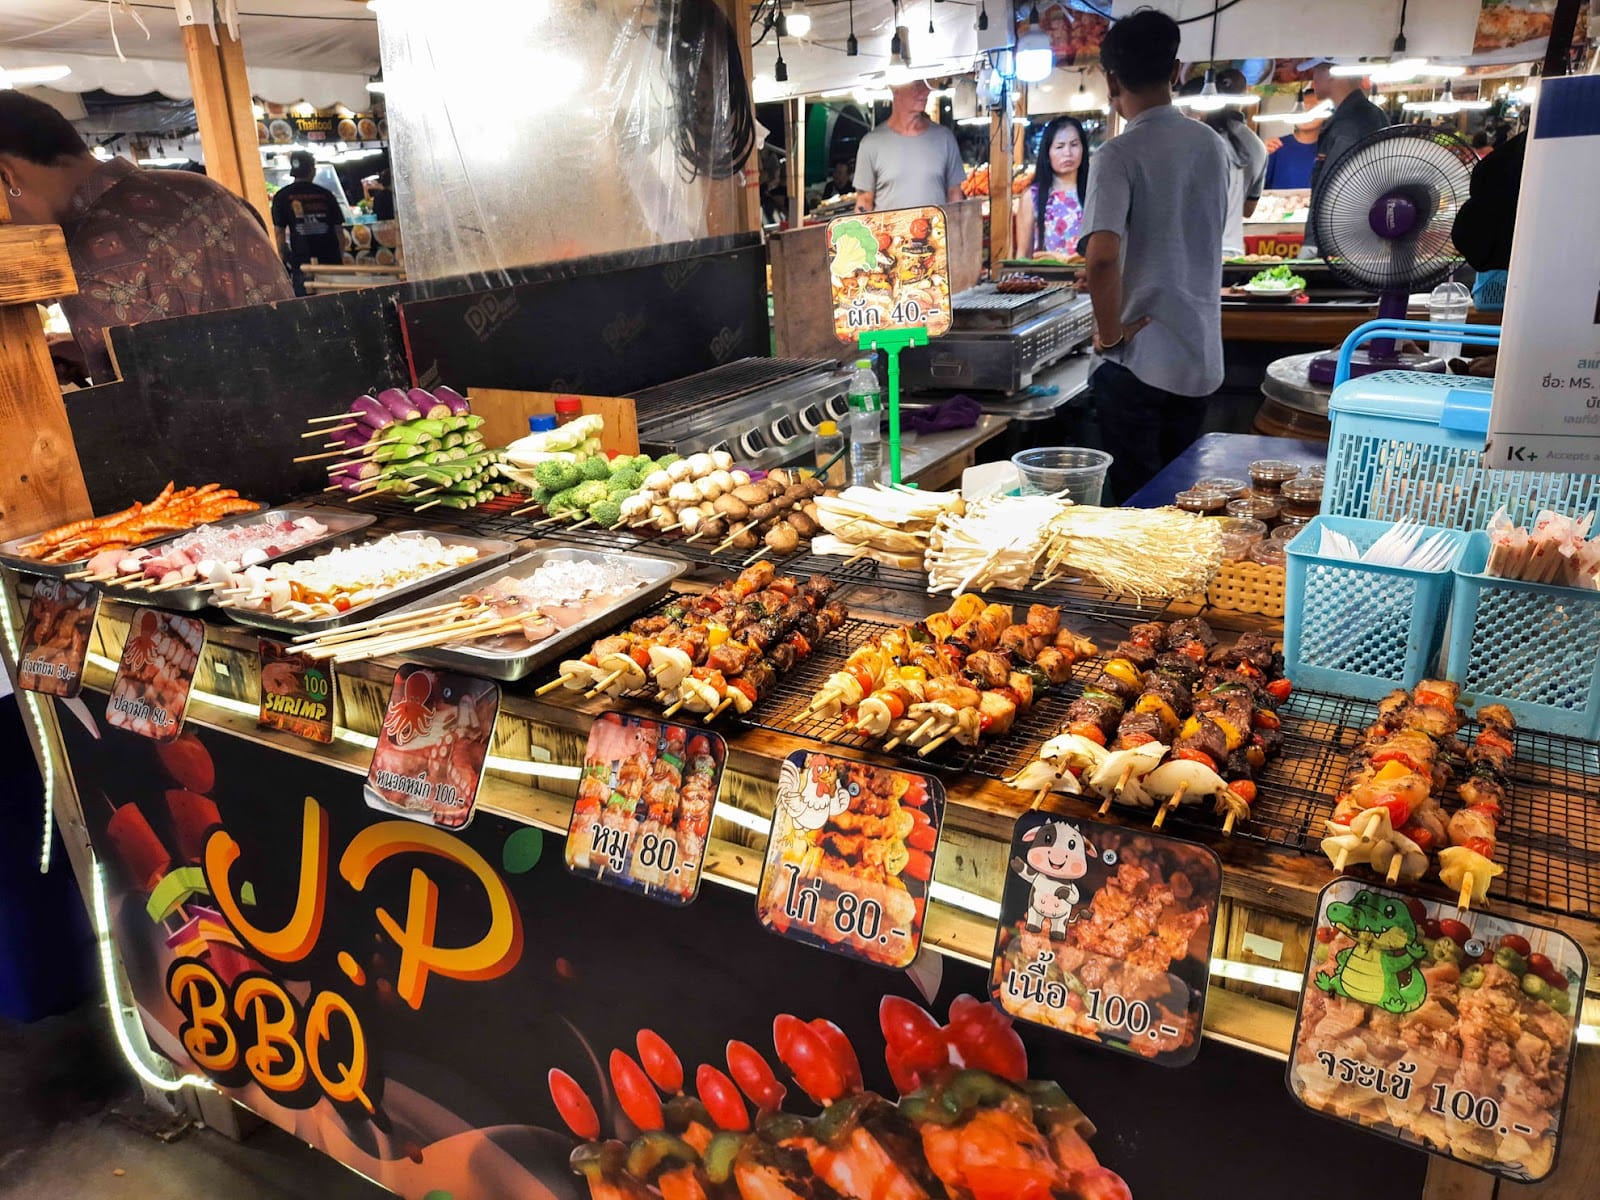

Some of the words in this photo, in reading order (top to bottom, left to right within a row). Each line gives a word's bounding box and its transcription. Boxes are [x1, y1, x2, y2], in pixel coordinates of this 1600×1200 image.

[296, 118, 332, 130] Thaifood
[848, 299, 879, 326] ผัก
[891, 301, 939, 324] 40.-
[1569, 377, 1595, 389] MS.
[1507, 446, 1538, 461] K+
[1546, 450, 1591, 461] Accepts
[304, 674, 328, 695] 100
[152, 706, 174, 726] 80.-
[265, 692, 327, 720] SHRIMP
[377, 771, 430, 798] หนวดหมึก
[435, 783, 464, 805] 100.-
[592, 824, 628, 871] หมู
[640, 834, 695, 874] 80.-
[784, 863, 821, 923] ไก่
[834, 893, 906, 944] 80.-
[1008, 951, 1067, 1009] เนื้อ
[1087, 990, 1178, 1039] 100.-
[170, 962, 376, 1114] BBQ
[1317, 1050, 1417, 1101] จระเข้
[1430, 1084, 1532, 1134] 100.-
